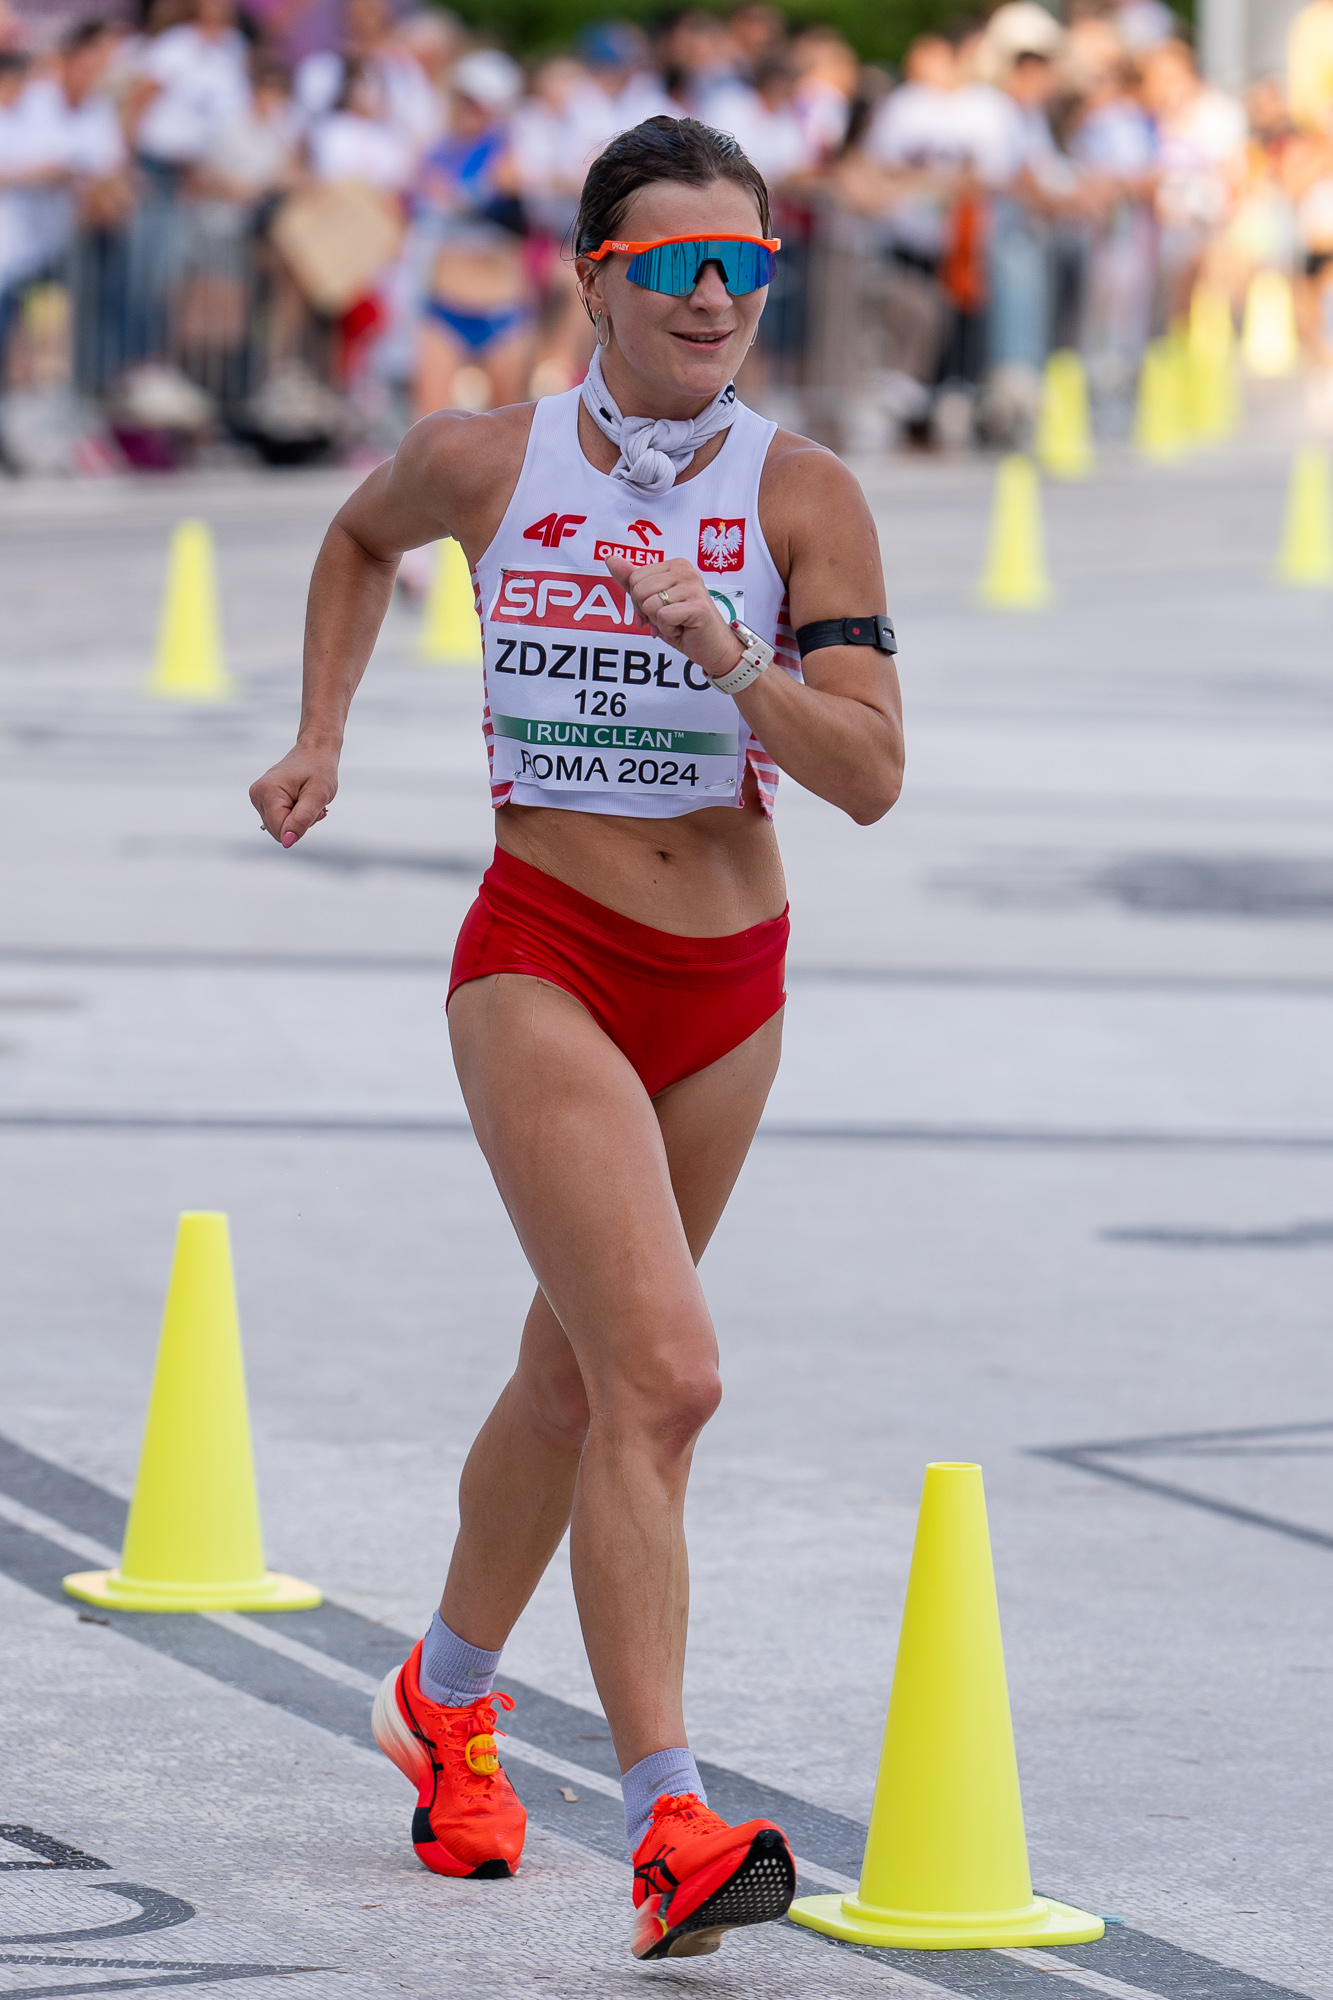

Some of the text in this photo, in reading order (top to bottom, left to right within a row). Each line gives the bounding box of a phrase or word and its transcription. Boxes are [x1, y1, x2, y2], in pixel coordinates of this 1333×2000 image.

[522, 512, 588, 548] 4F
[598, 544, 660, 565] ORLEN
[499, 578, 635, 626] SPA
[574, 689, 627, 717] 126
[527, 722, 532, 740] I
[536, 723, 588, 744] RUN
[520, 749, 700, 787] ROMA 2024
